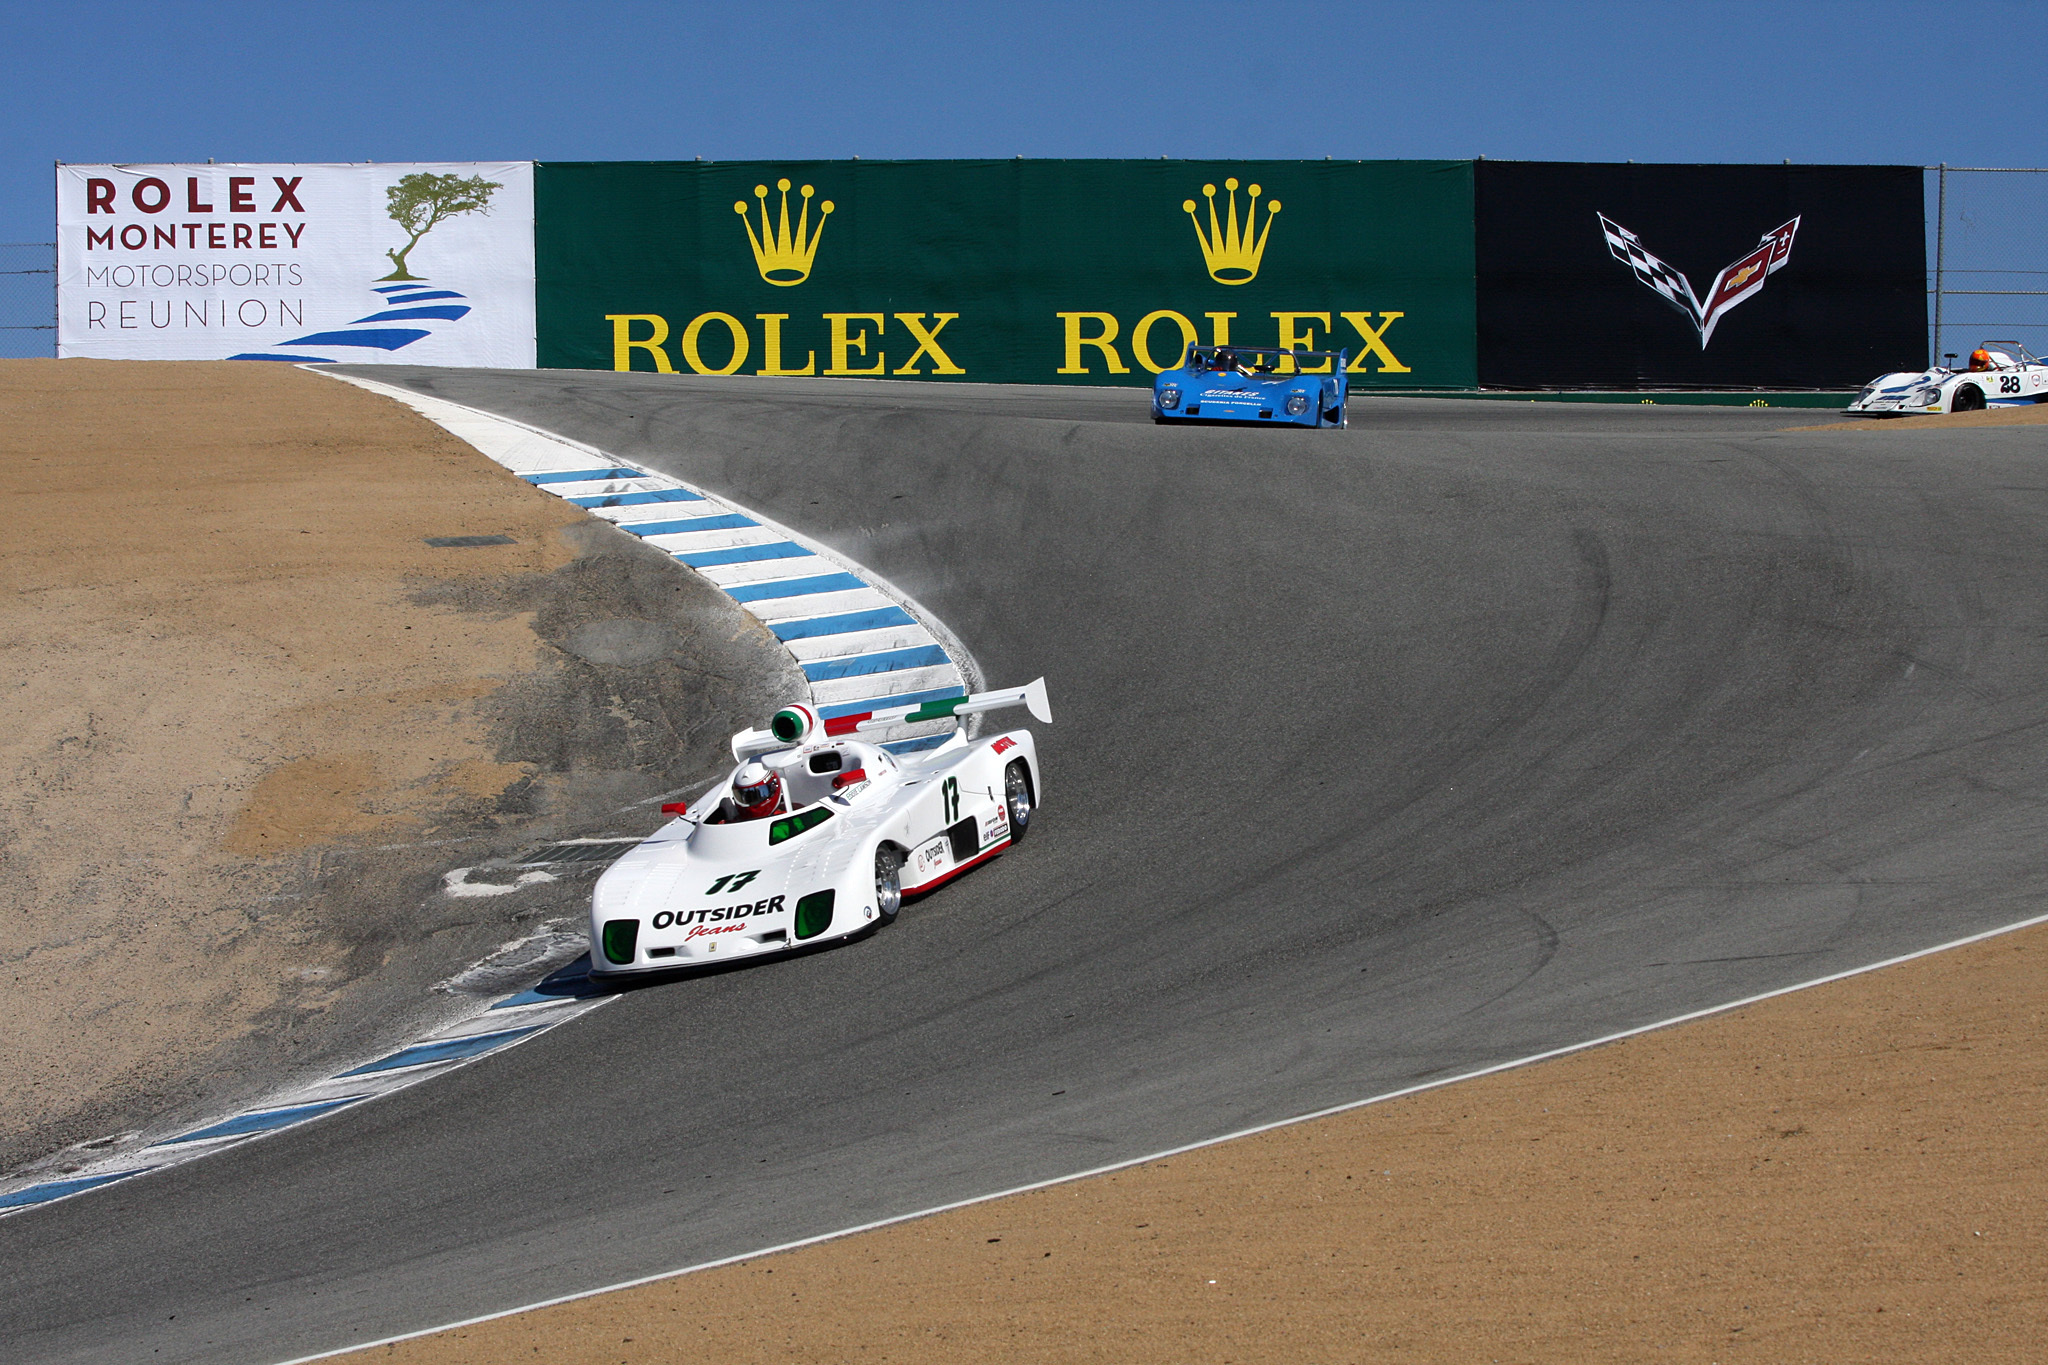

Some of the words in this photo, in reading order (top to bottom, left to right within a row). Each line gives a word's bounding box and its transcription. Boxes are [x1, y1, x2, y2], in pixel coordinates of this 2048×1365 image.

[87, 177, 305, 214] ROLEX
[87, 223, 305, 250] MONTEREY
[87, 263, 302, 288] MOTORSPORTS
[88, 299, 302, 329] REUNION
[605, 311, 965, 376] ROLEX
[1056, 309, 1411, 374] ROLEX
[1999, 375, 2021, 394] 28
[941, 775, 960, 825] 17
[925, 840, 944, 862] OUTSIDER
[704, 869, 762, 895] 17
[652, 894, 786, 930] OUTSIDER
[684, 922, 748, 942] Jeans
